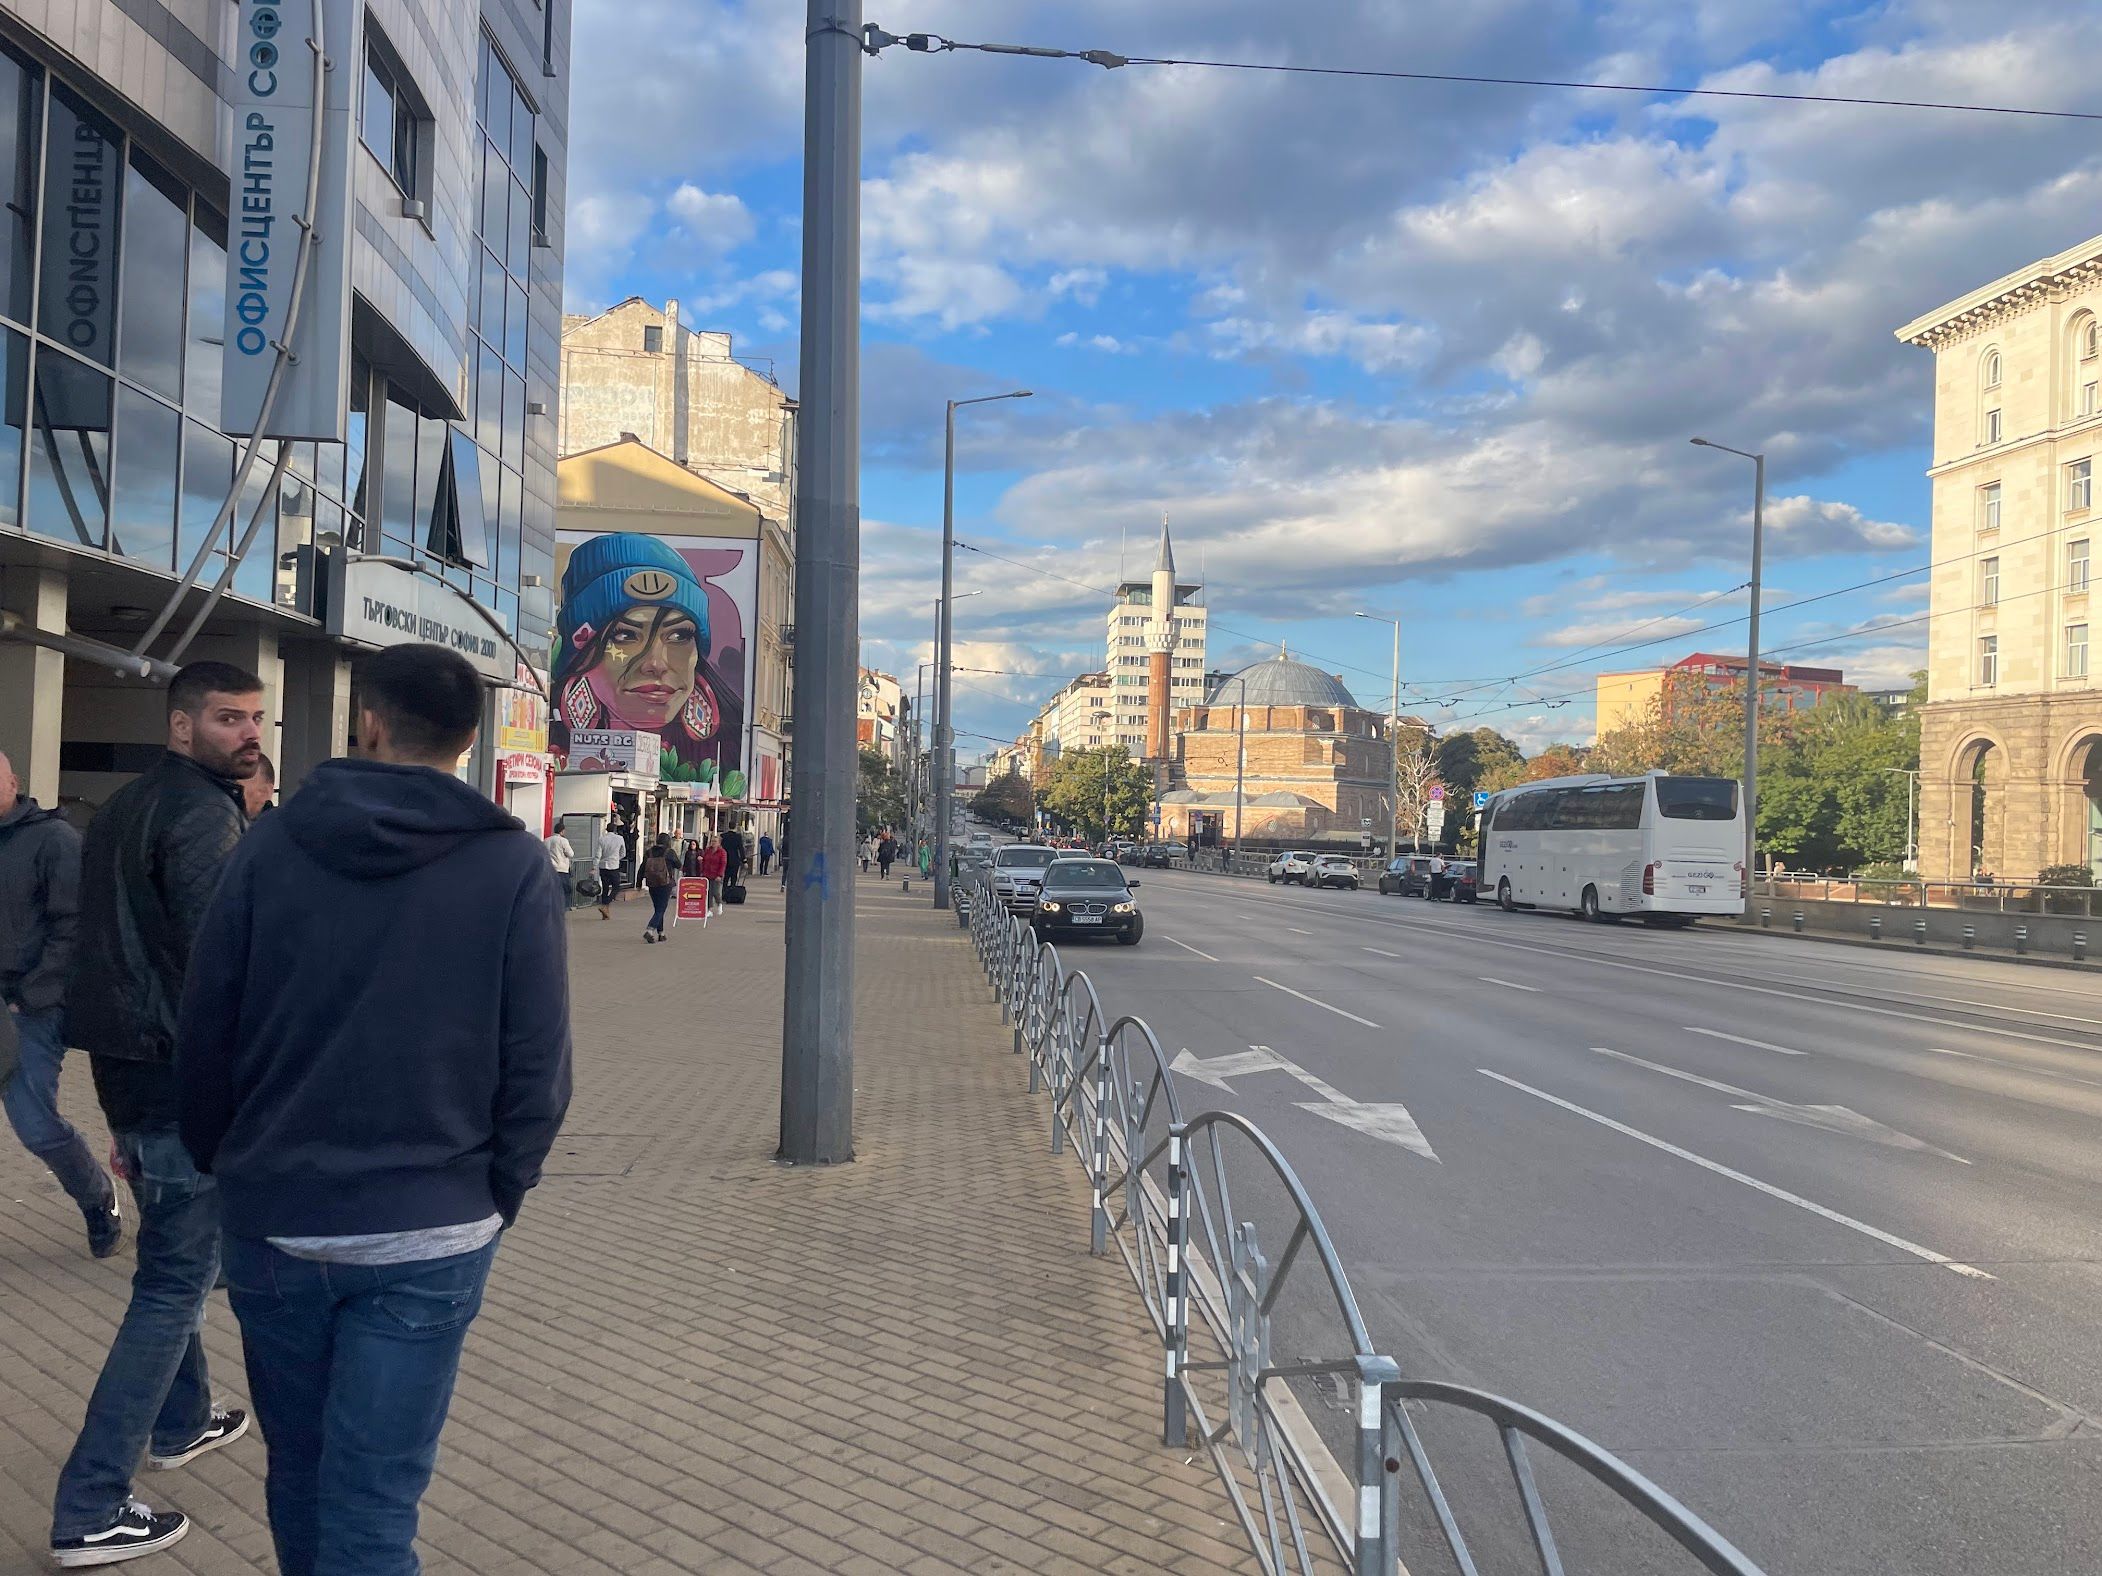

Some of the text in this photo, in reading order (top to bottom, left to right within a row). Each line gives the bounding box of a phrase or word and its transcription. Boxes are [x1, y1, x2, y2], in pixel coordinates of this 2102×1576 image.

[236, 0, 282, 356] ОФИСЦЕНТЪР СОФ
[363, 596, 497, 660] ТЪРГОВСКИ ЦЕНТЪР СОФИЯ 2000
[574, 734, 609, 745] NUTS
[614, 735, 632, 746] BG
